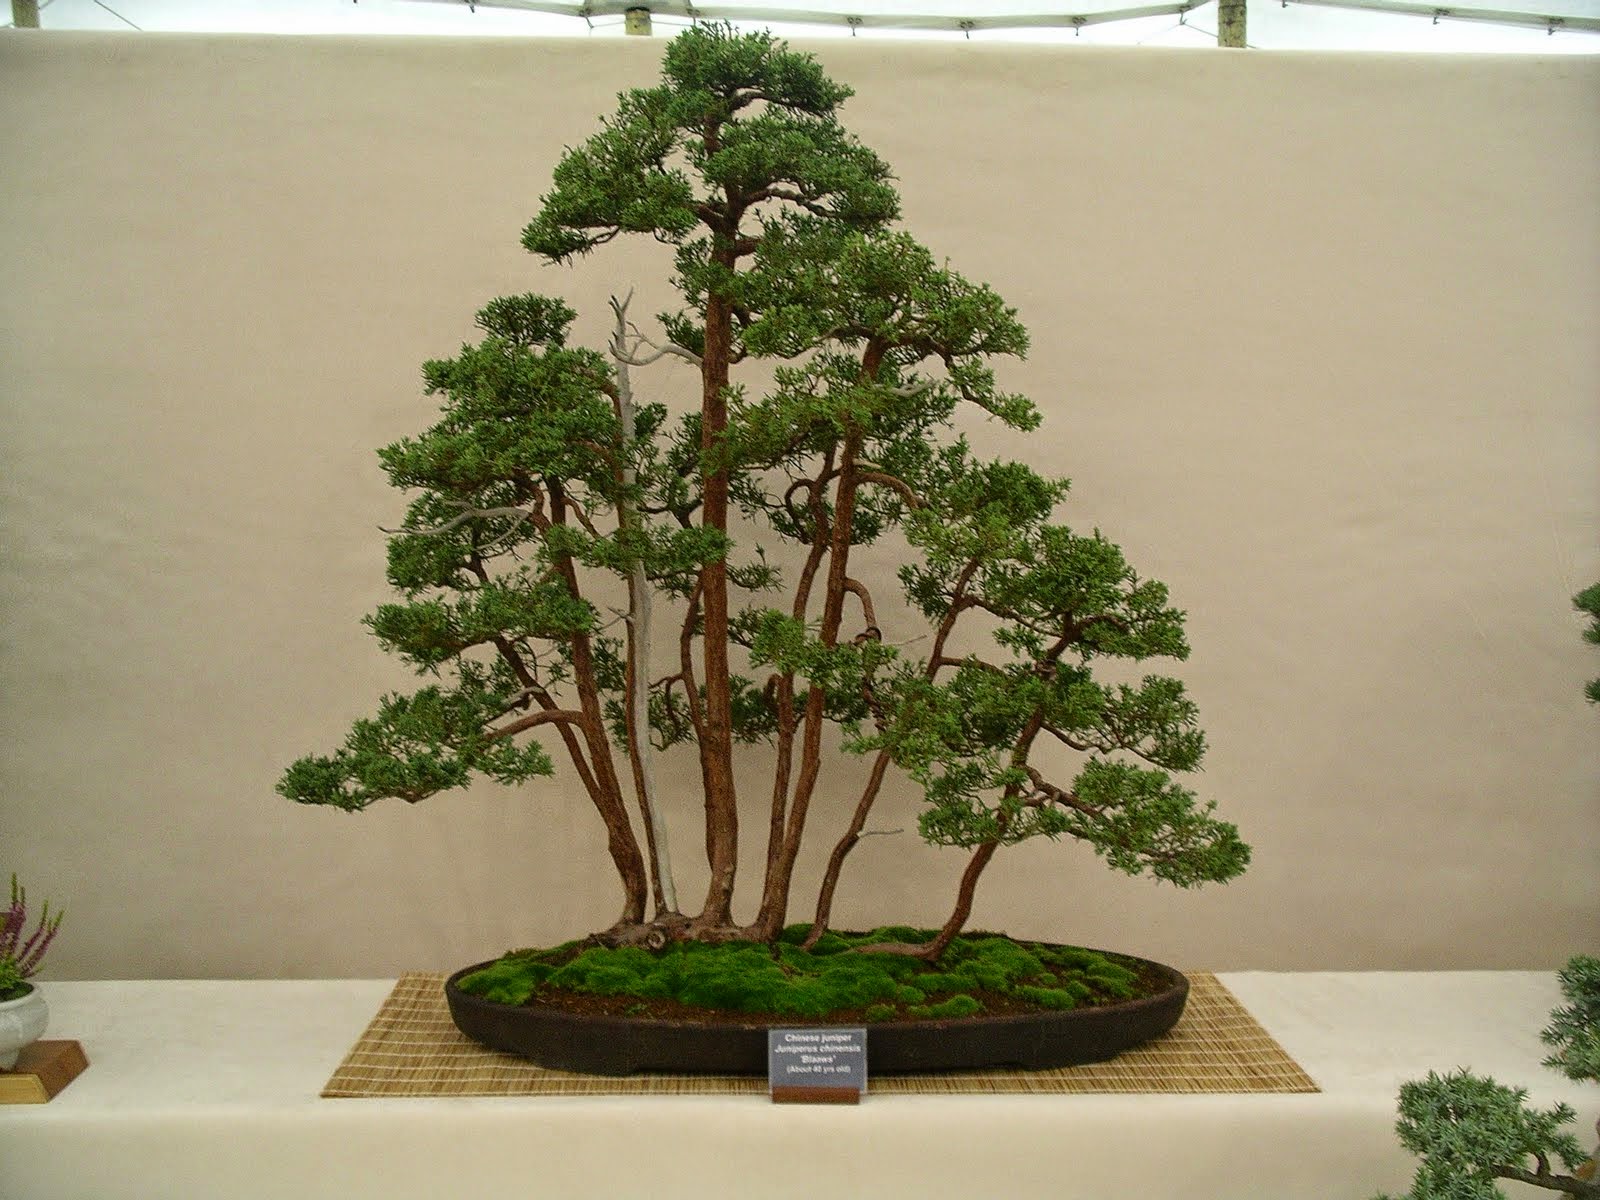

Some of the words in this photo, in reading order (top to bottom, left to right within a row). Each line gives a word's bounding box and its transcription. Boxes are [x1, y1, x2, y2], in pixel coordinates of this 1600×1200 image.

[785, 1034, 820, 1042] Chinese
[821, 1034, 852, 1043] juniper
[775, 1045, 818, 1054] Juniperus
[820, 1045, 861, 1053] chinensis
